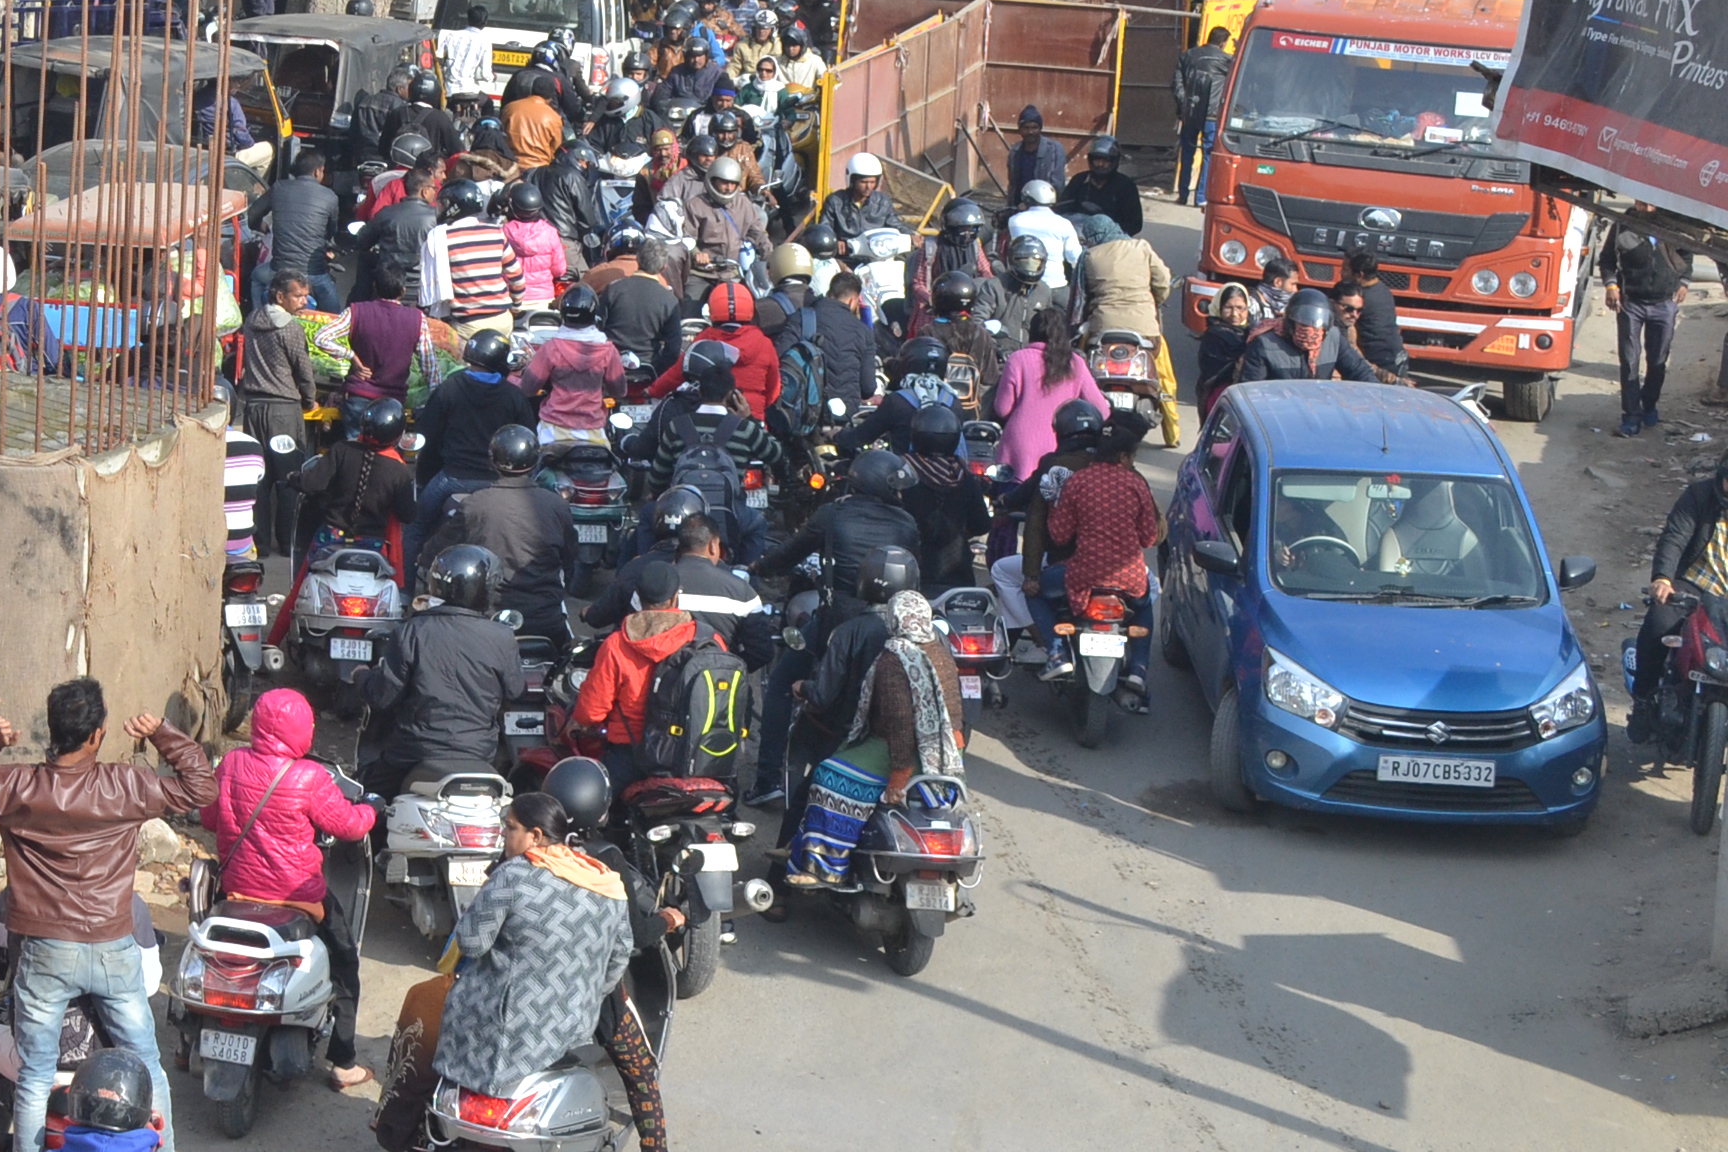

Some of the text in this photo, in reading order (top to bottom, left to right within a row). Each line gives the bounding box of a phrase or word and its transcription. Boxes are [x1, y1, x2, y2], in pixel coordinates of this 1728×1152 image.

[1294, 37, 1329, 49] EICHER
[1586, 27, 1608, 42] Type
[1349, 39, 1391, 52] PUNJAB
[1393, 43, 1431, 56] MOTOR
[1433, 47, 1472, 59] WORKS
[1670, 40, 1728, 90] Printers
[1313, 227, 1445, 257] EICHER
[1391, 760, 1493, 783] RJ07CB5332
[212, 1032, 249, 1050] RJ01D
[211, 1046, 247, 1062] S4058
